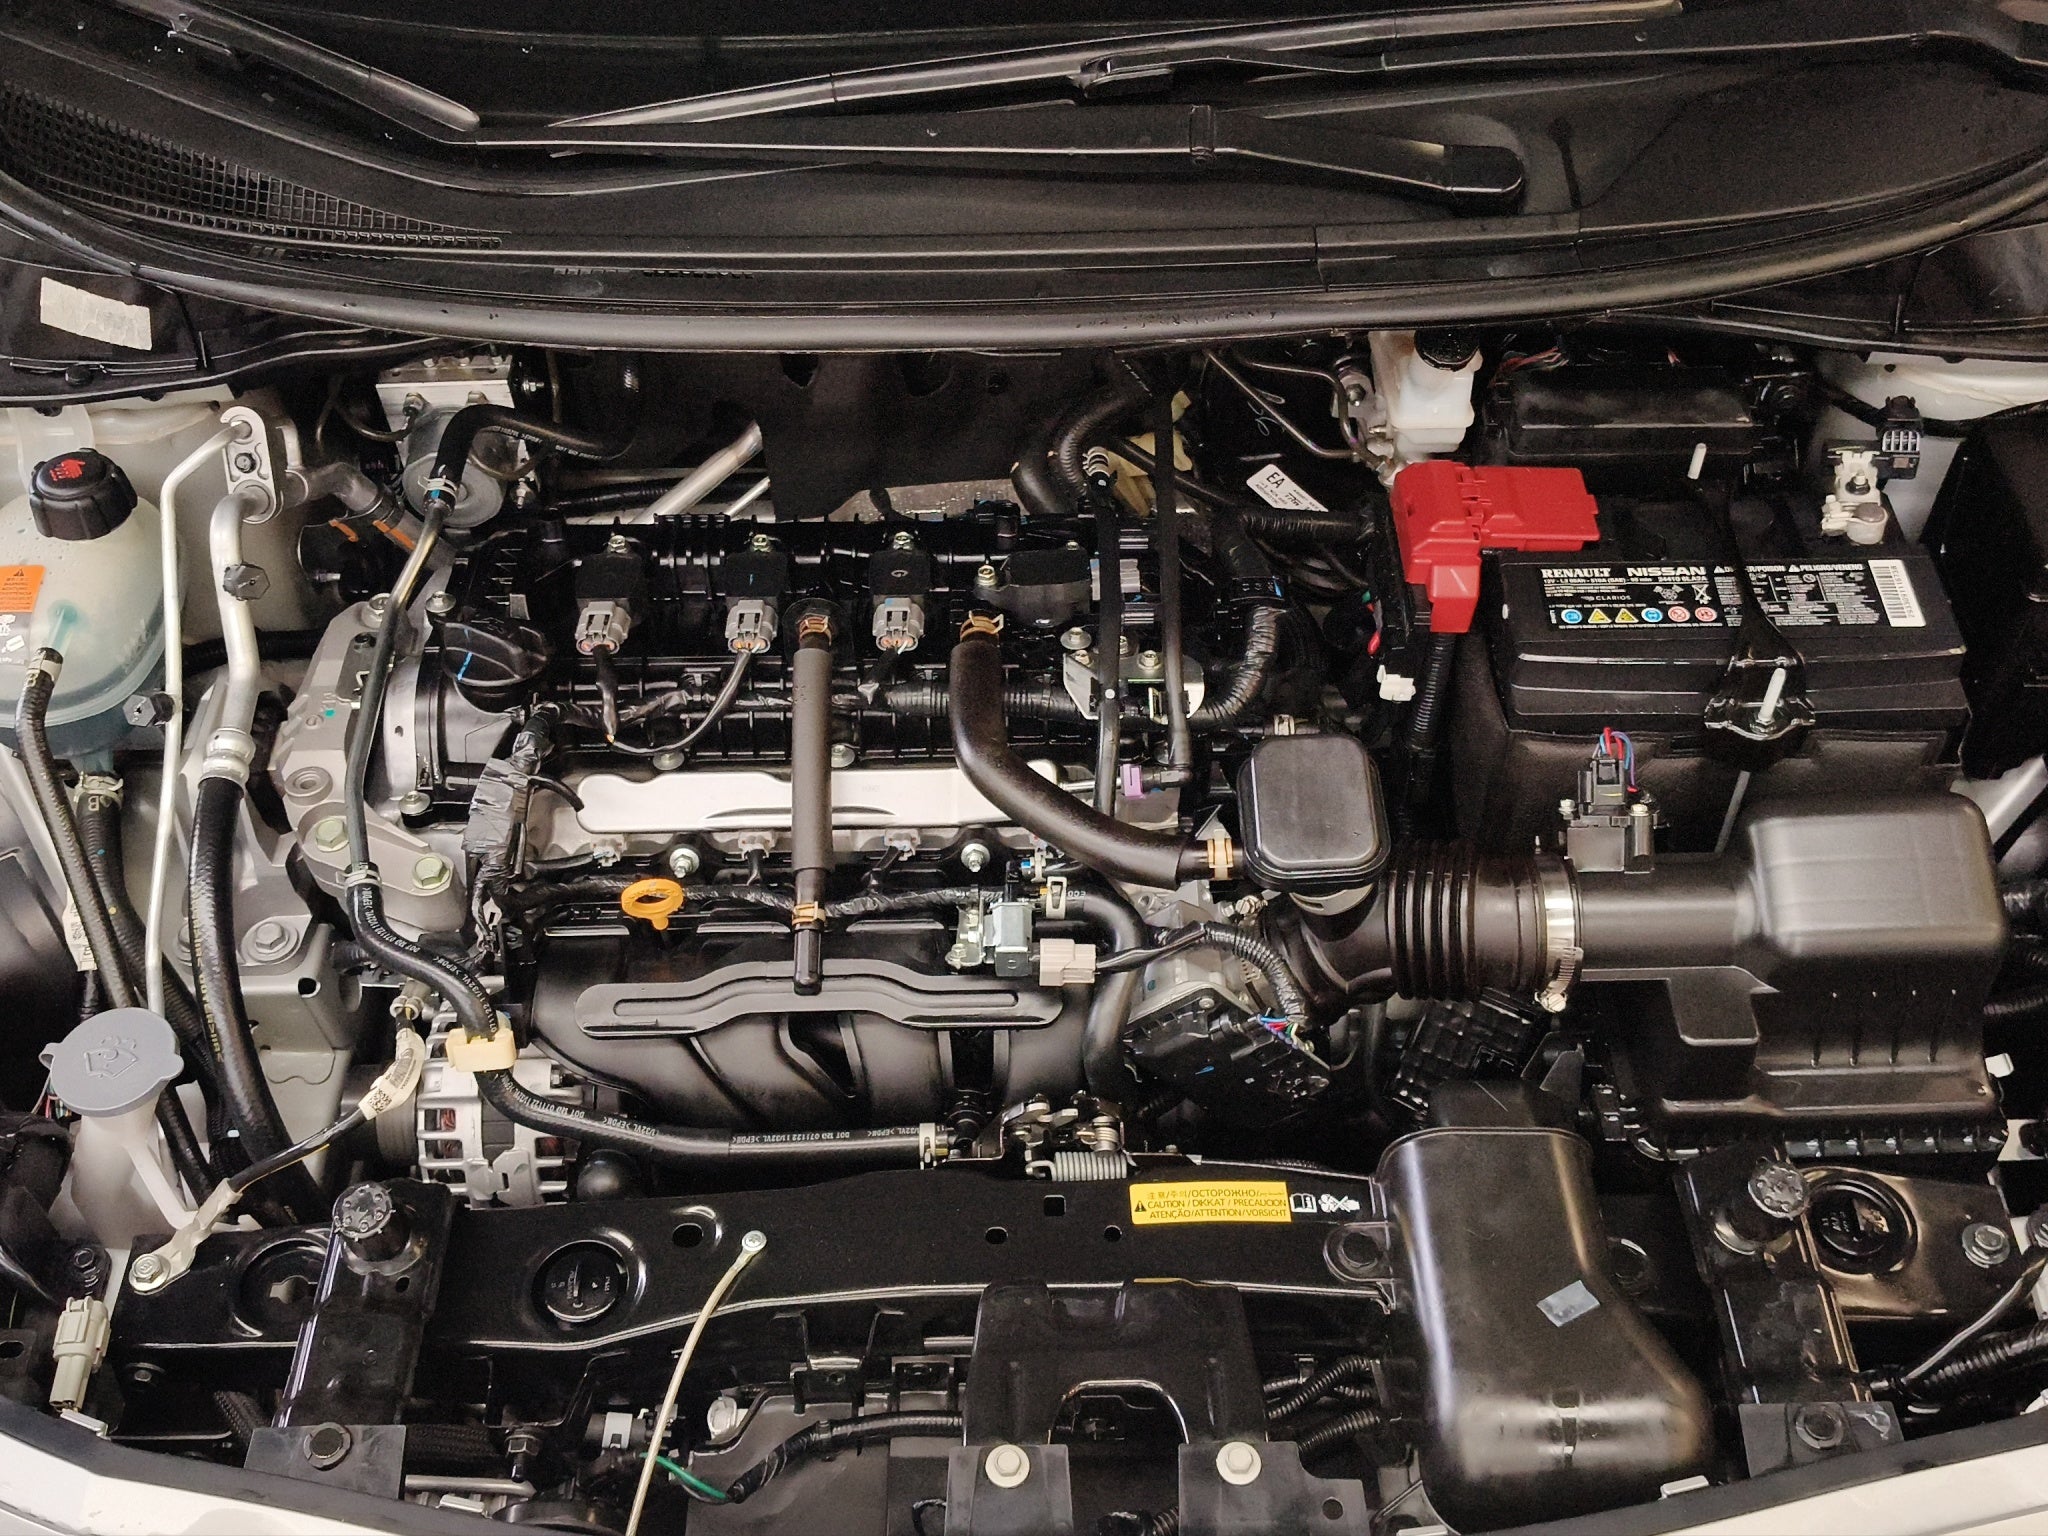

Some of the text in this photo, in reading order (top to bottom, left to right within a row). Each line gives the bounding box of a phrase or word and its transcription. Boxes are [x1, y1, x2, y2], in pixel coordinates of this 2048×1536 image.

[1541, 566, 1706, 578] RENAULT NISSAN
[1147, 1200, 1185, 1209] CAUTION
